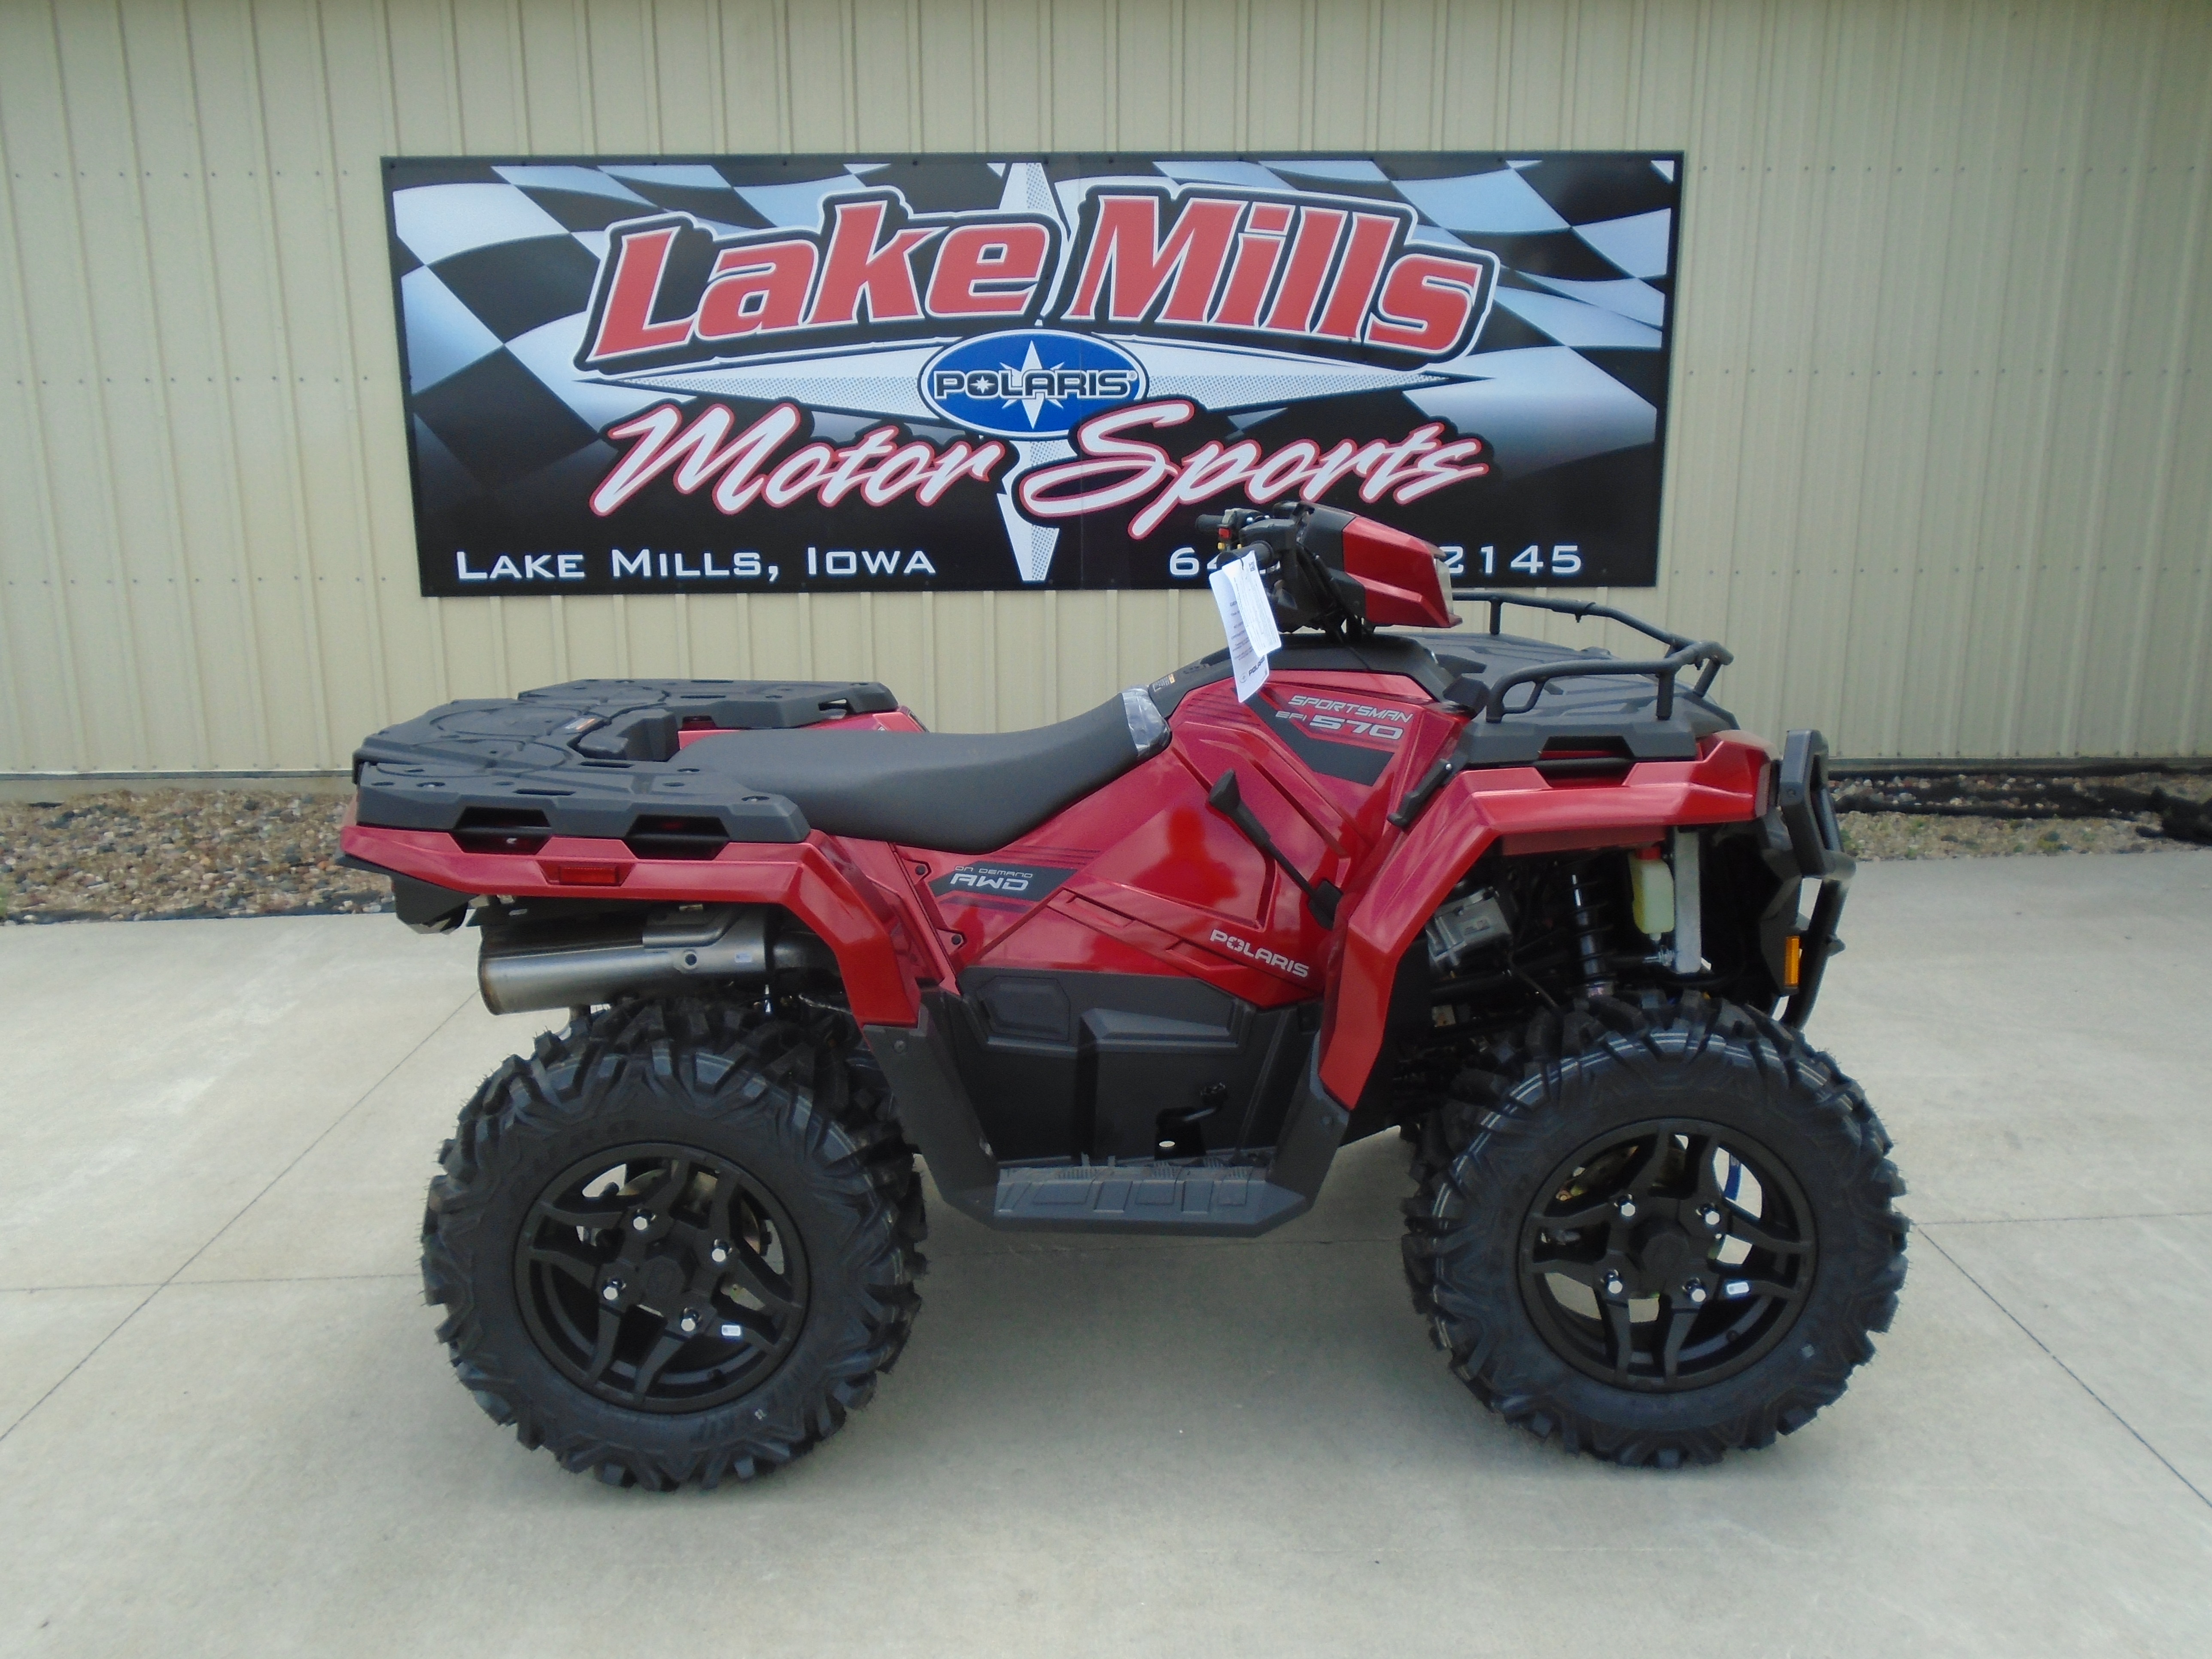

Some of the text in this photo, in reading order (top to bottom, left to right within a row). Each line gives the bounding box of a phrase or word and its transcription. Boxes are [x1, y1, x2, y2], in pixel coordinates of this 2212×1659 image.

[586, 195, 1483, 362] Lake Mills
[934, 369, 1131, 400] POLARIS
[589, 400, 1490, 540] Motor Sports
[1288, 695, 1413, 723] SPORTSMAN
[1275, 711, 1404, 740] EFI 570
[950, 873, 1029, 891] AWD
[978, 868, 1033, 878] DEMAND
[1210, 929, 1309, 978] POLARIS
